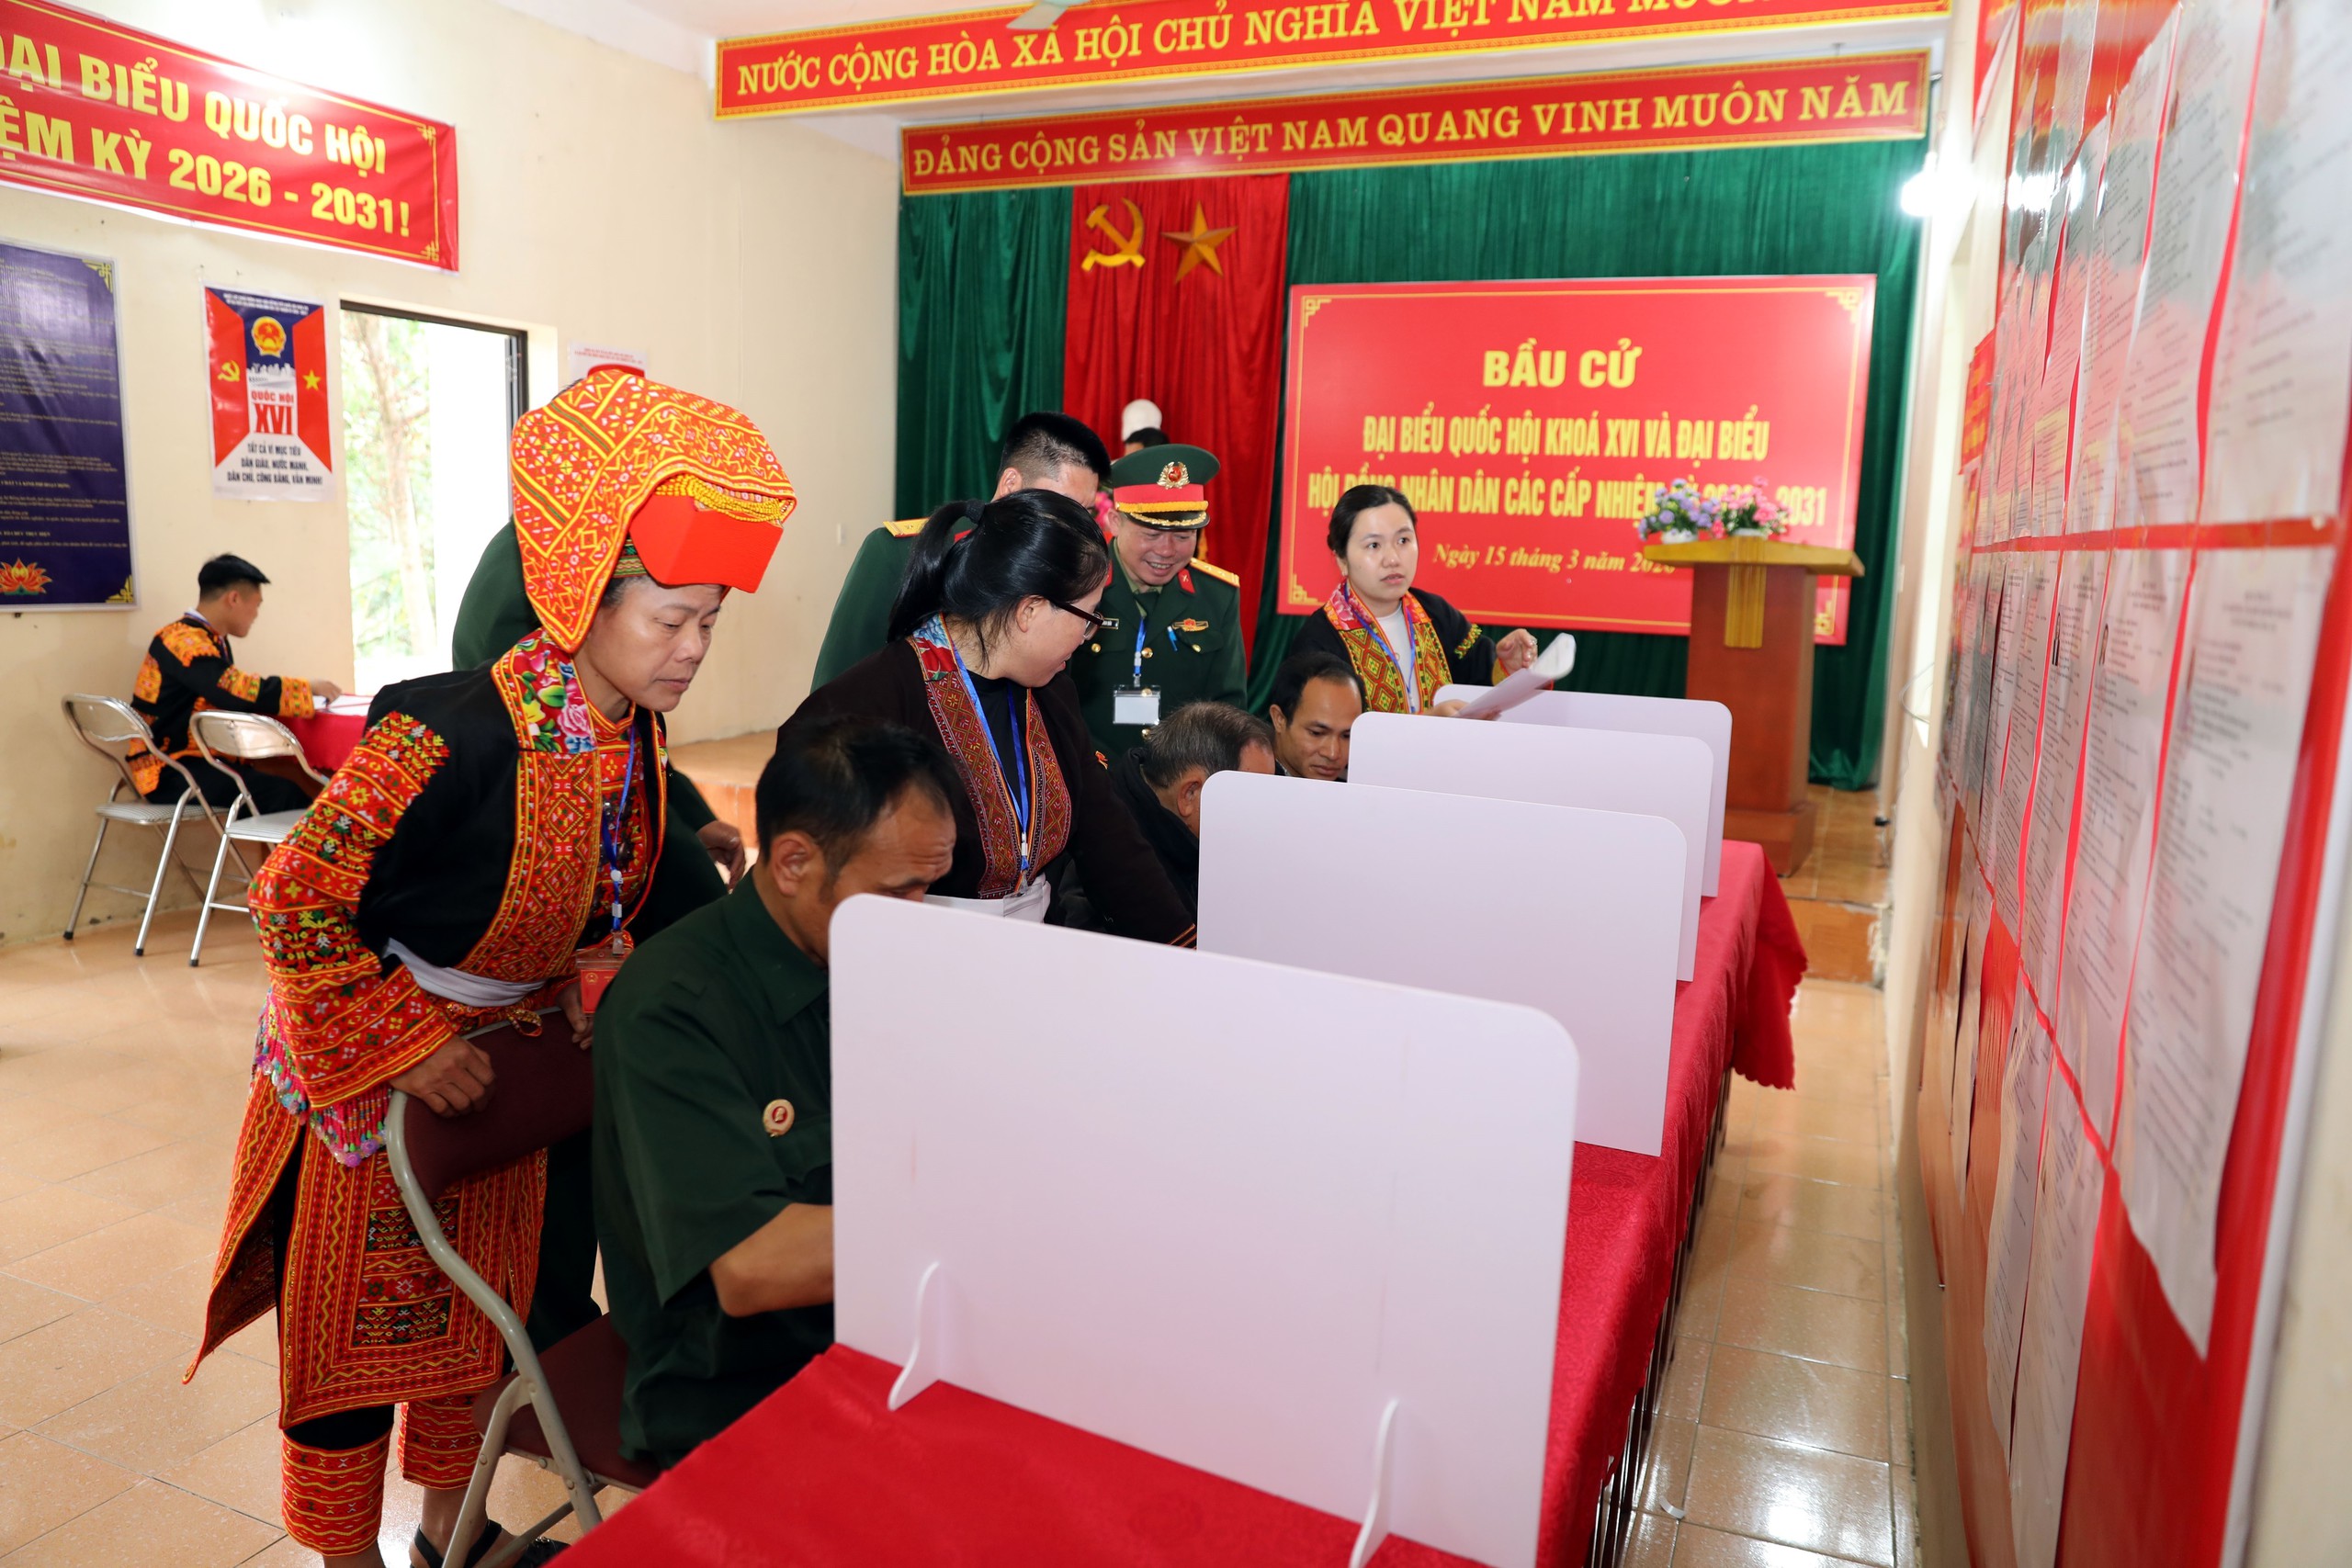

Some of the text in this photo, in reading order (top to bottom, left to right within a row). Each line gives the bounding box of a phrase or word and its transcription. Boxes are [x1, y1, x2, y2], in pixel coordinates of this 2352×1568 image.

[738, 48, 820, 95] NƯỚC
[829, 42, 918, 92] CỘNG
[927, 30, 1001, 75] HÒA
[1074, 14, 1143, 68] HỘI
[1154, 0, 1234, 53] CHỦ
[0, 33, 386, 177] ẠI BIỂU QUỐC HỘI
[914, 75, 1910, 177] ĐẢNG CỘNG SẢN VIỆT NAM QUANG VINH MUÔN NĂM
[91, 126, 152, 181] KỲ
[168, 147, 272, 208] 2026
[284, 189, 299, 204] -
[311, 182, 411, 237] 2031!
[1483, 337, 1643, 389] BẦU CỬ
[254, 402, 292, 434] XVI
[1363, 401, 1770, 468] ĐẠI BIỂU QUỐC HỘI KHOÁ XVI VÀ ĐẠI BIỂU
[1307, 466, 1340, 517] HỘI
[1400, 468, 1454, 513] NHÂN
[1458, 468, 1500, 514] DÂN
[1504, 469, 1546, 516] CÁC
[1549, 466, 1592, 517] CẤP
[1432, 544, 1480, 570] Ngày
[1485, 546, 1507, 566] 15
[1510, 547, 1564, 573] tháng
[1566, 548, 1580, 570] 3
[1583, 550, 1625, 571] năm
